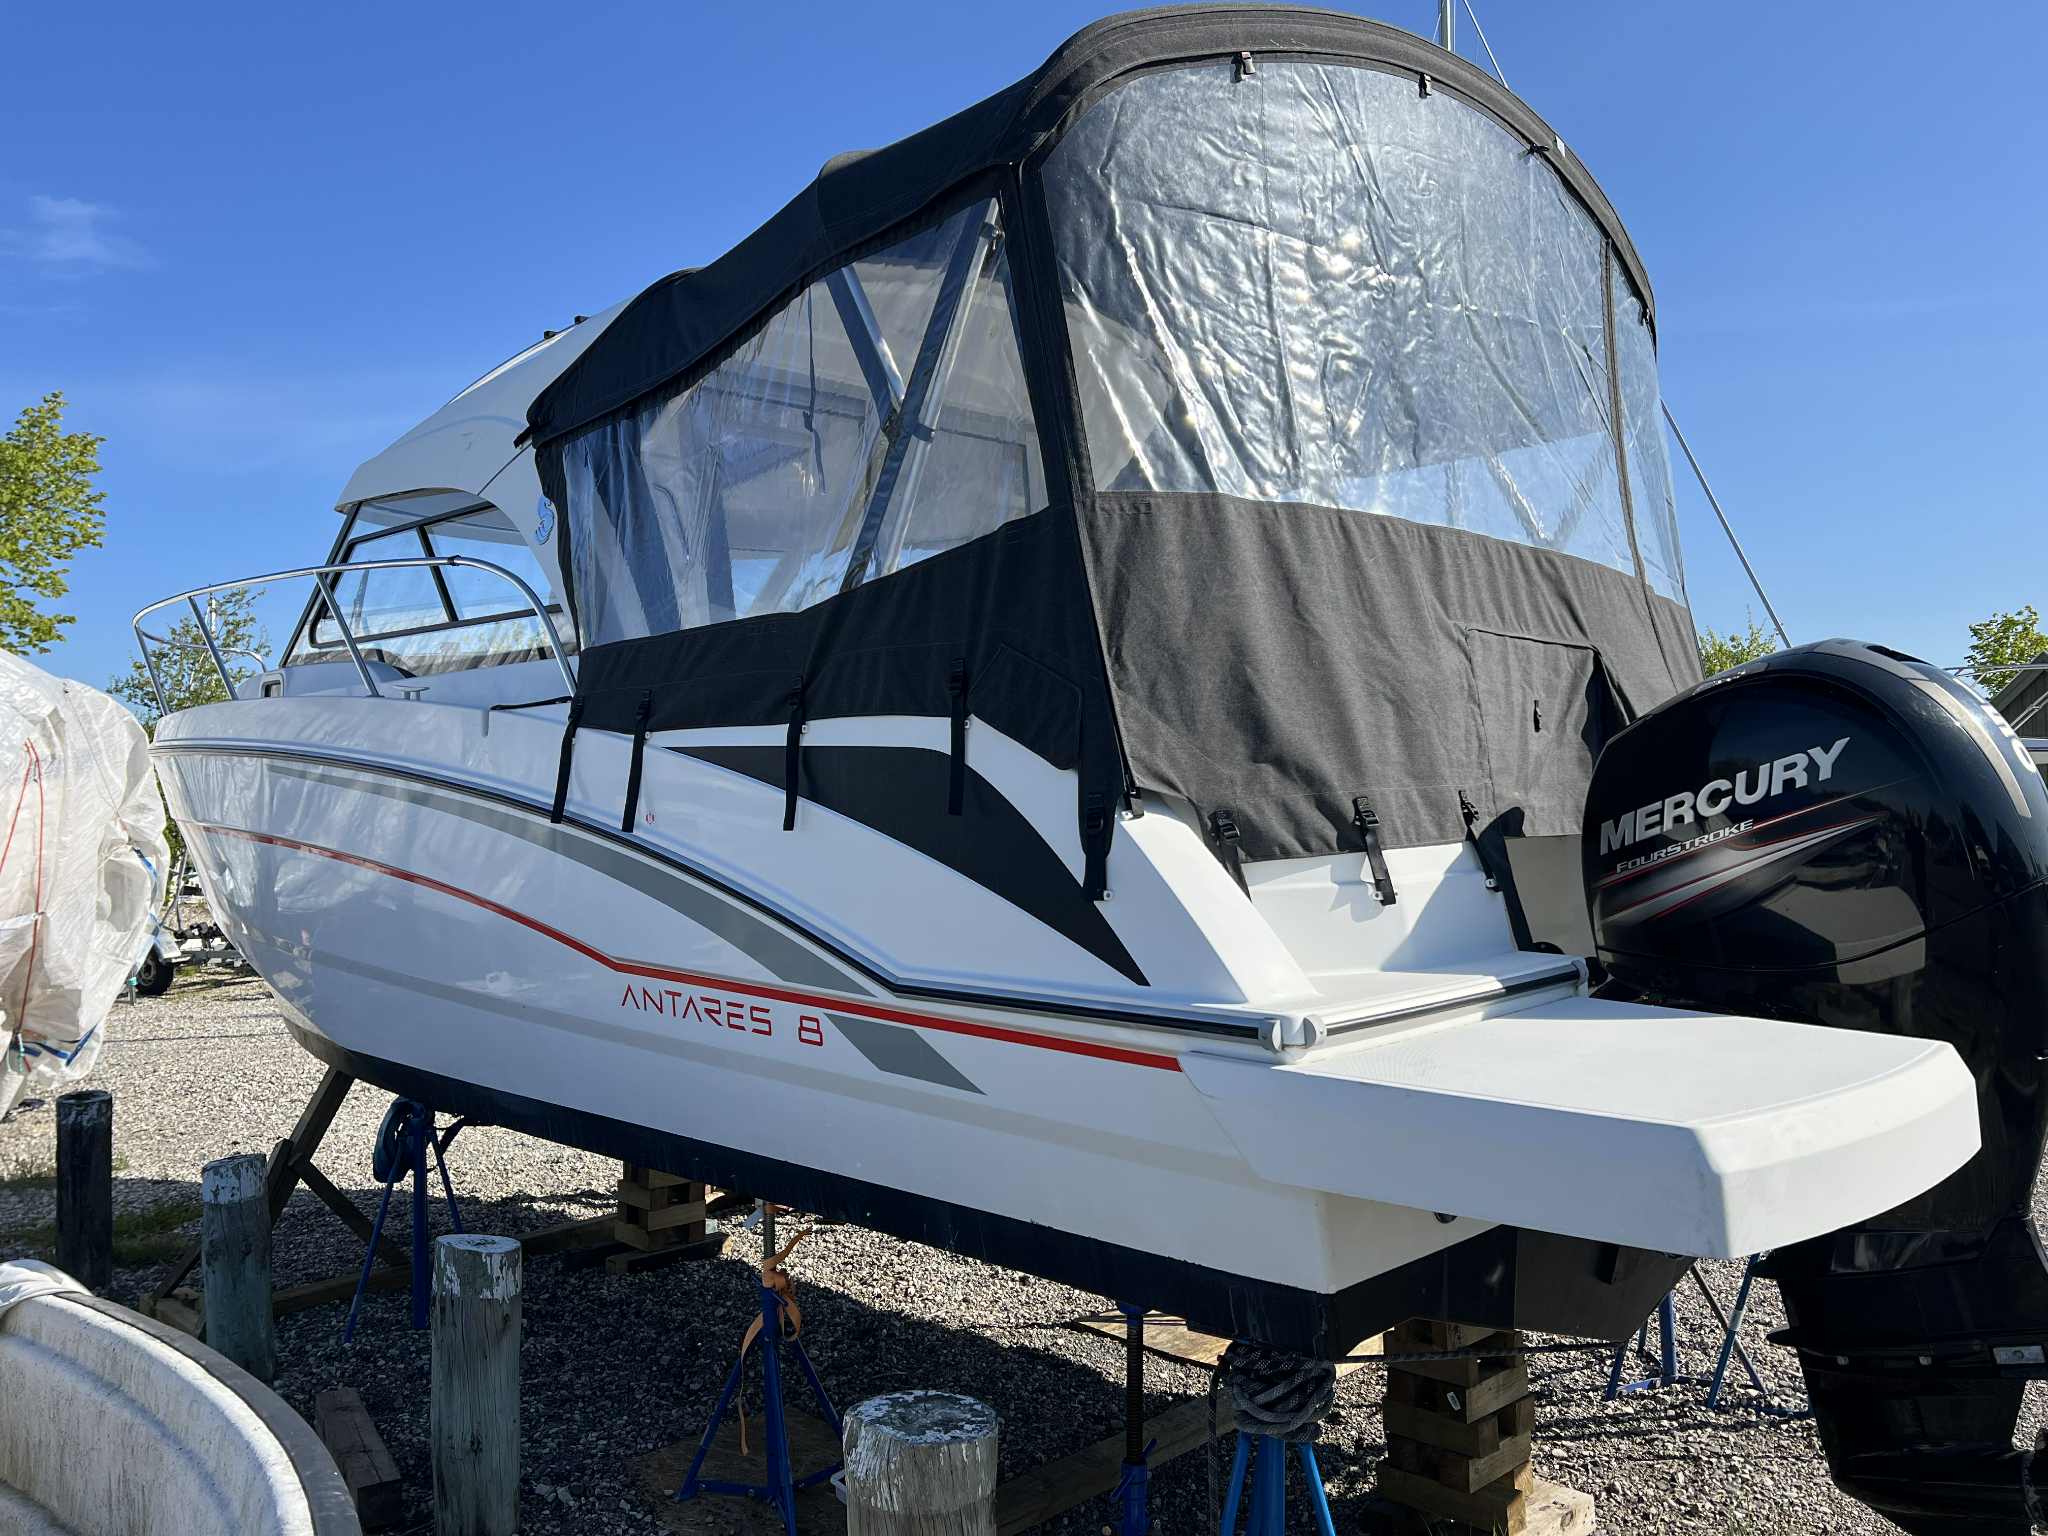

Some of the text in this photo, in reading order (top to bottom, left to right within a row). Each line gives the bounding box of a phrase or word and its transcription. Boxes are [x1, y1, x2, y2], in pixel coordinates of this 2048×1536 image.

[1601, 737, 1850, 855] MERCURY
[1616, 819, 1754, 873] FOURSTROKE
[621, 984, 824, 1046] ANTARES 8
